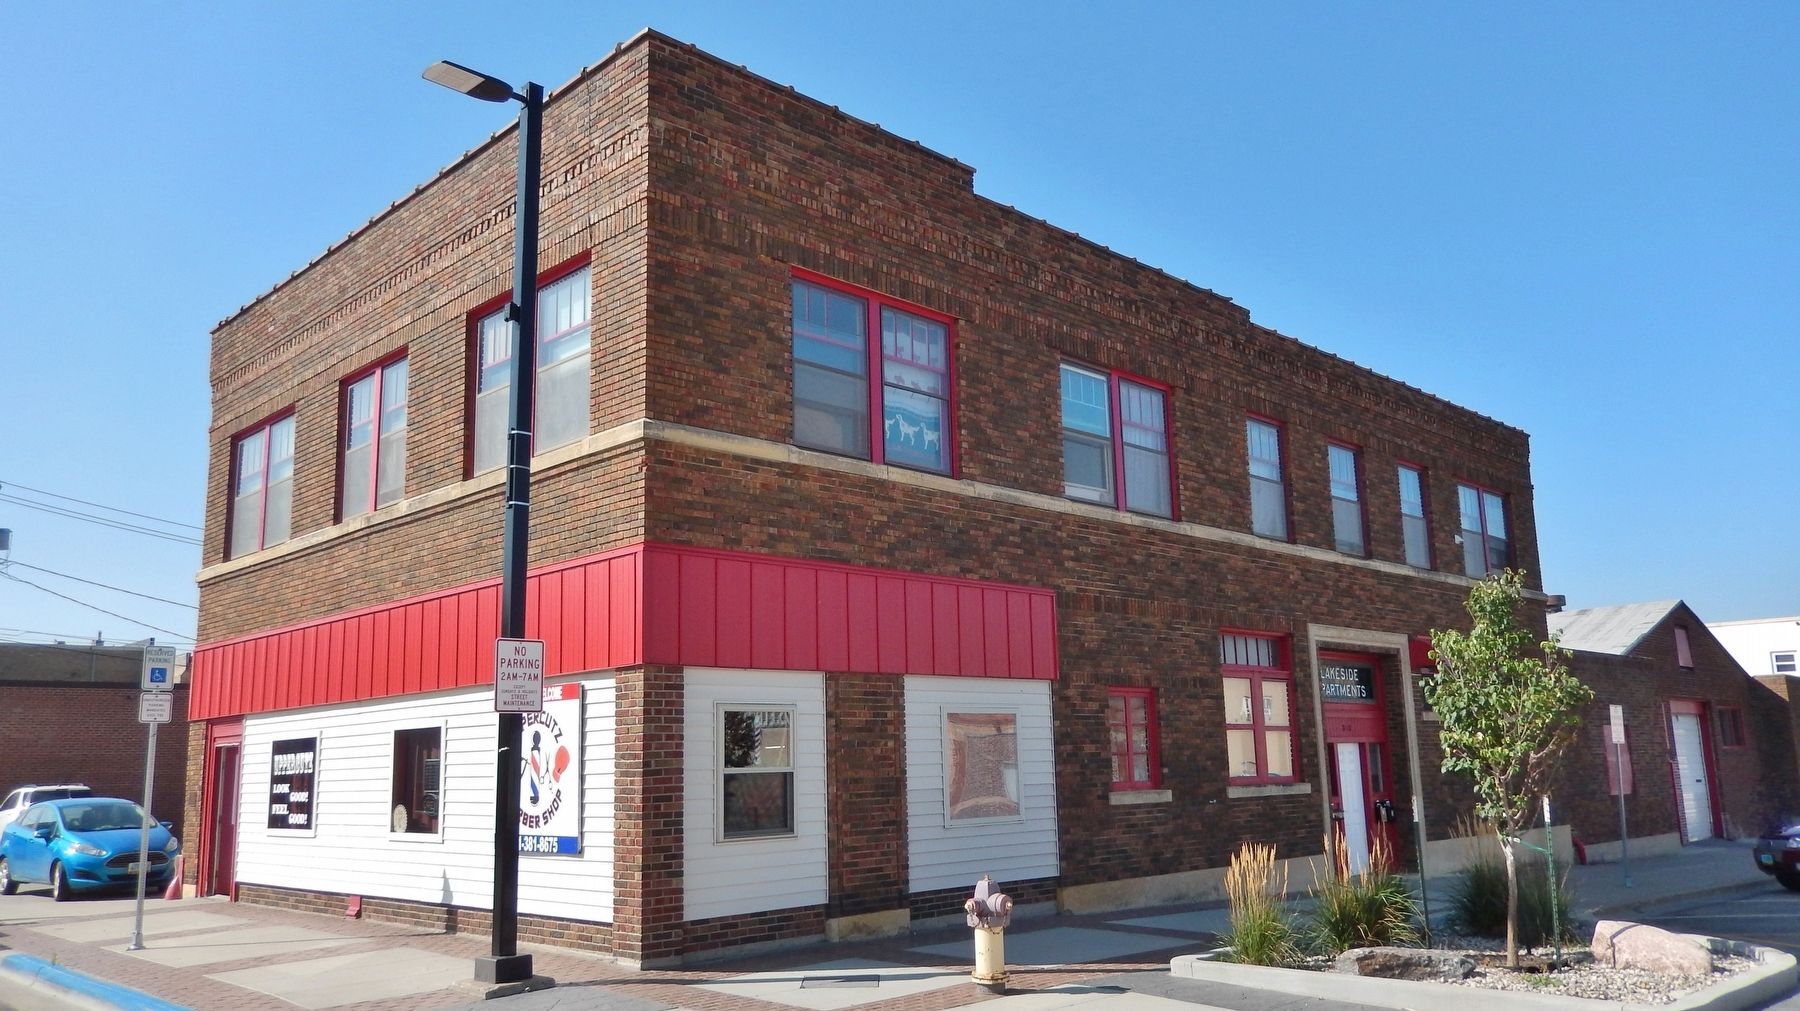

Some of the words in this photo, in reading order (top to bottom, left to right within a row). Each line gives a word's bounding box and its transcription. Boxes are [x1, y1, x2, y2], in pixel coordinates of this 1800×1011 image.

[514, 646, 527, 656] NO
[500, 657, 540, 669] PARKING
[500, 672, 539, 681] 2AM-7AM
[1320, 667, 1359, 681] LAKESIDE
[1321, 683, 1367, 697] PARTMENTS
[273, 784, 290, 793] LOOK
[289, 792, 309, 802] GOOD!
[271, 804, 289, 814] FEEL
[542, 788, 562, 825] SHOP
[288, 814, 308, 824] GOOD!
